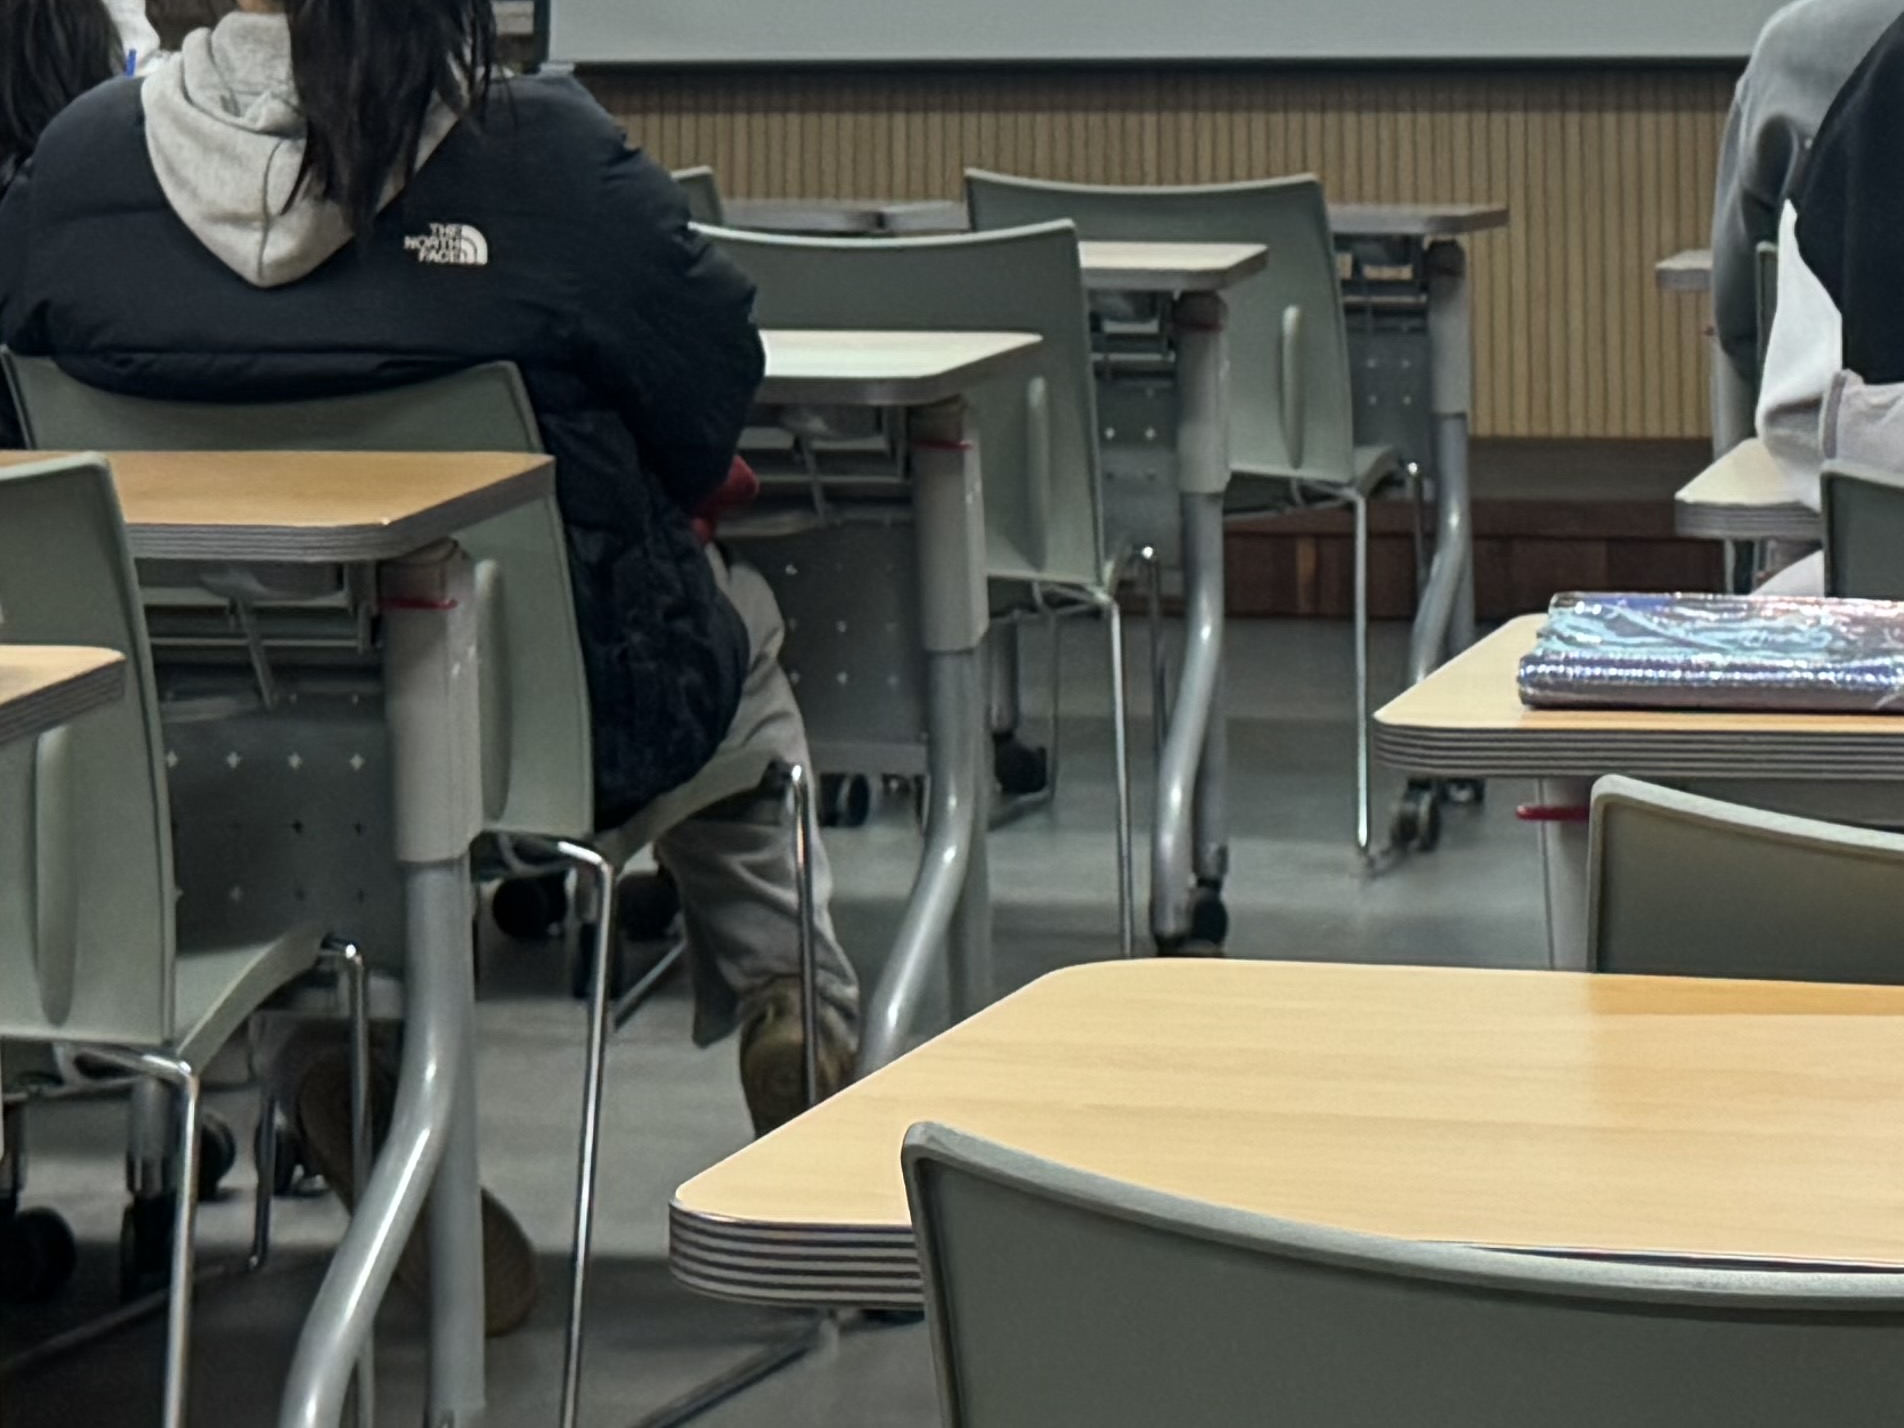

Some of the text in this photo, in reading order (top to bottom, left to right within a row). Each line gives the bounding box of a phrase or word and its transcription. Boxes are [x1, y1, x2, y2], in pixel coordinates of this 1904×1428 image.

[429, 222, 462, 238] THE
[403, 235, 462, 250] NORTH
[418, 248, 462, 264] FACE
